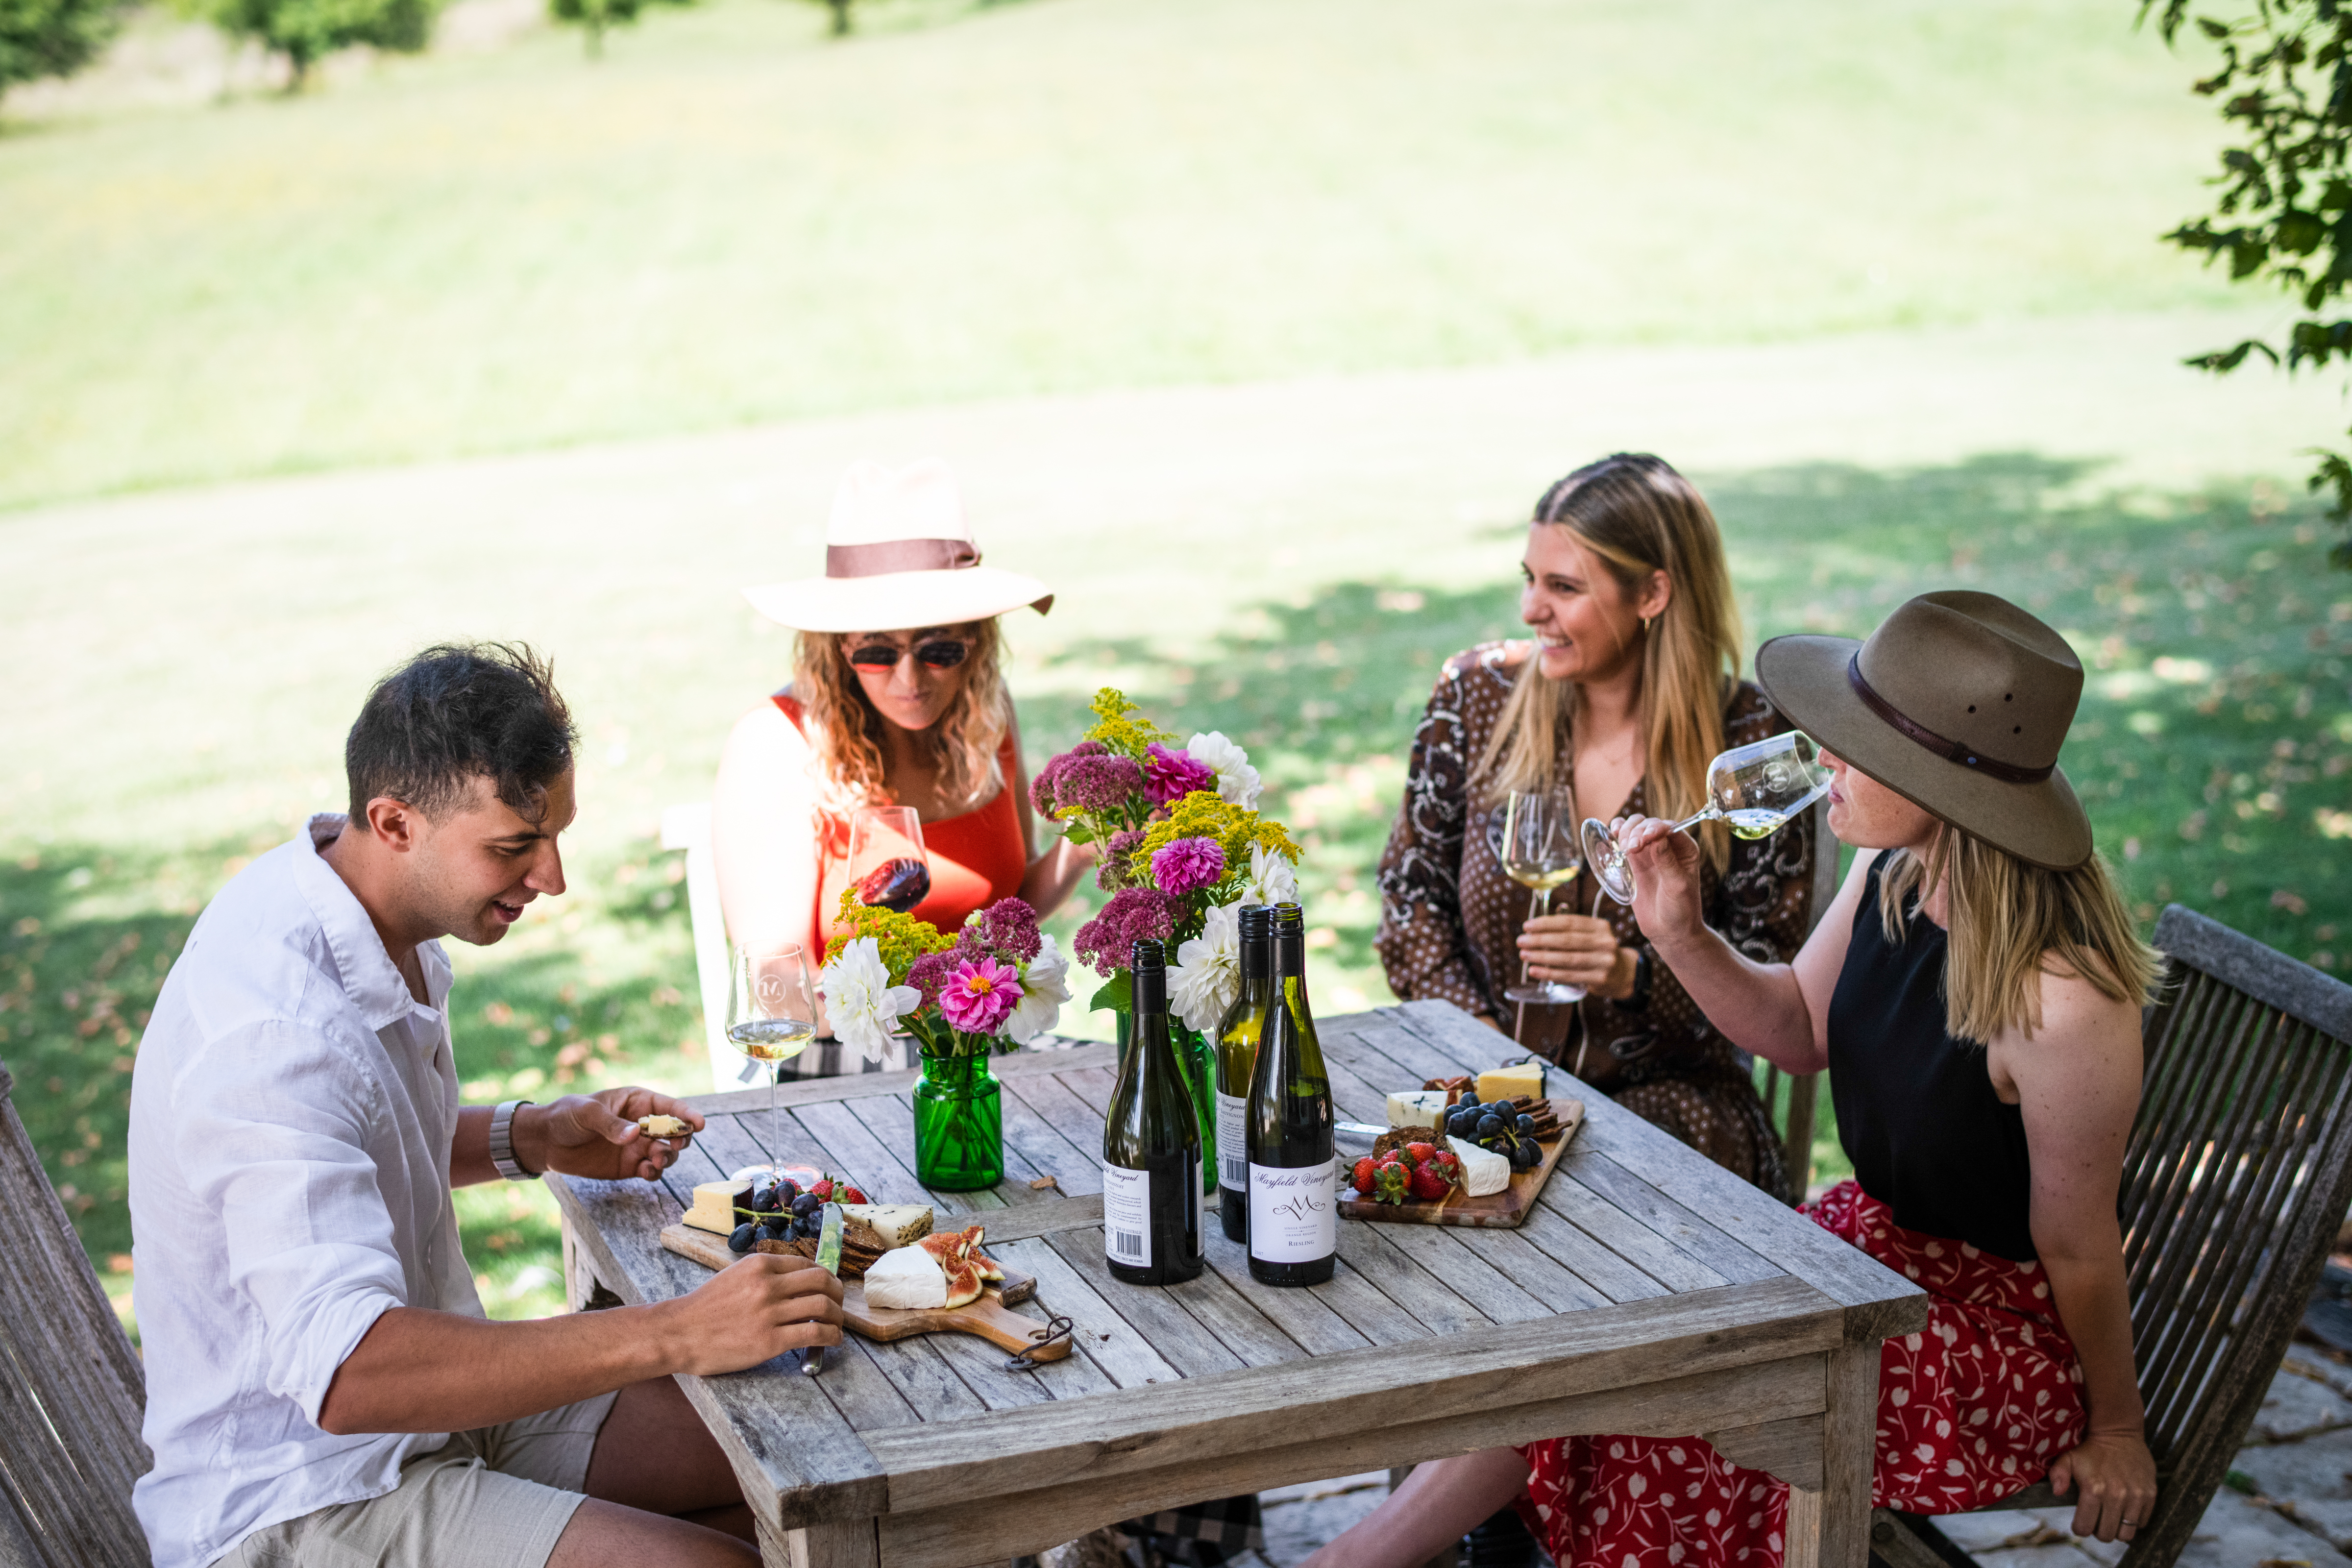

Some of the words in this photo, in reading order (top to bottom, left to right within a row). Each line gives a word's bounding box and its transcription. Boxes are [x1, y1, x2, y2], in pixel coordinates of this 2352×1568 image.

[760, 981, 781, 996] M
[1221, 1108, 1244, 1119] SAUVIGNON
[1111, 1168, 1139, 1182] Vineyard
[1254, 1172, 1298, 1189] Mayfield
[1301, 1166, 1335, 1186] Vineyard
